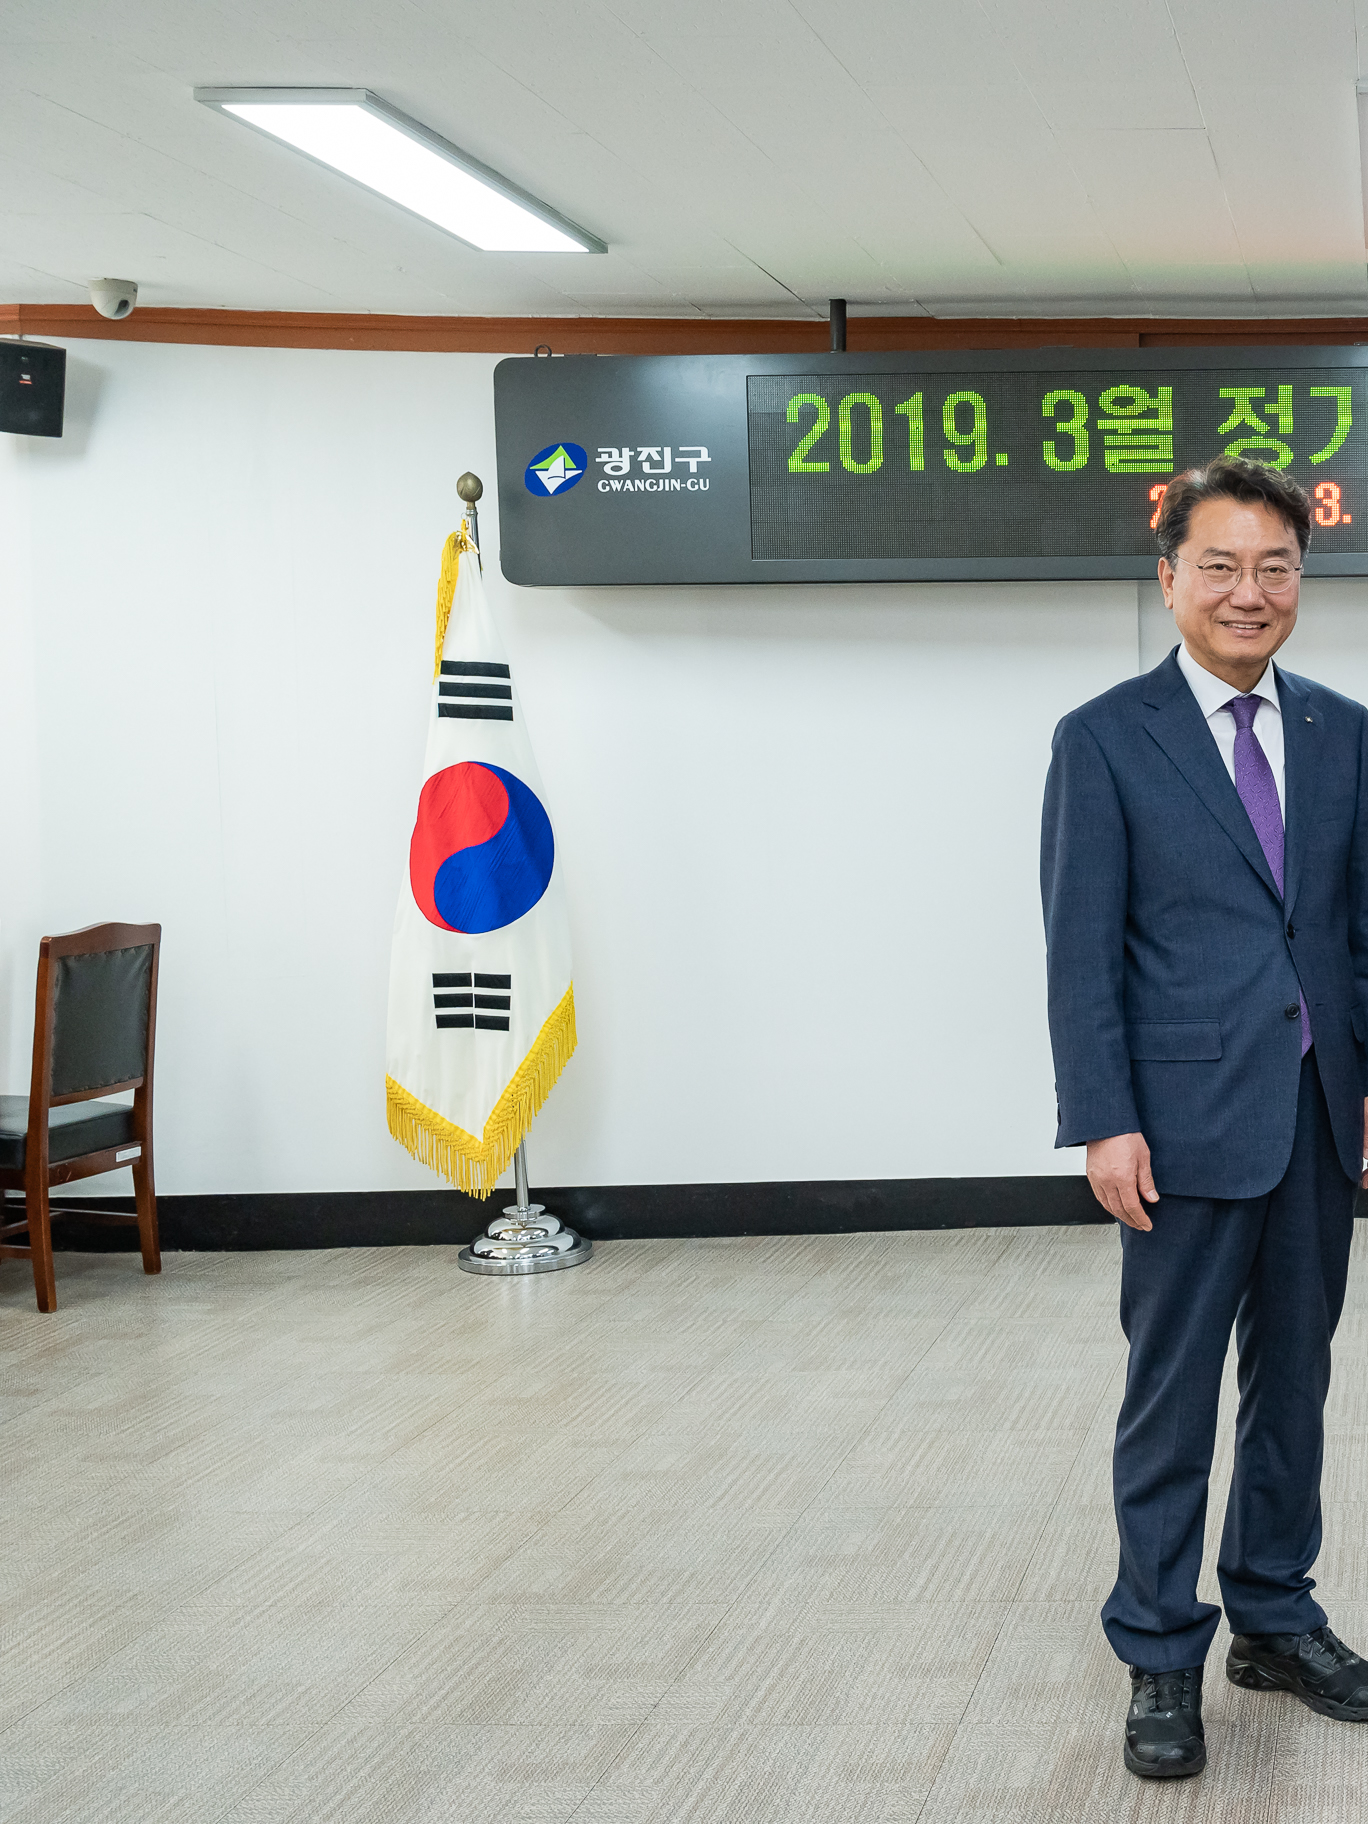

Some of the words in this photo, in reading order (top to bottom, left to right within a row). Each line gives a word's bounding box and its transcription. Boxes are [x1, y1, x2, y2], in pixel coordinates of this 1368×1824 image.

[787, 391, 1008, 474] 2019.
[1042, 385, 1174, 473] 3월
[595, 446, 712, 475] 광진구
[597, 478, 710, 492] GWANGJIN-GU
